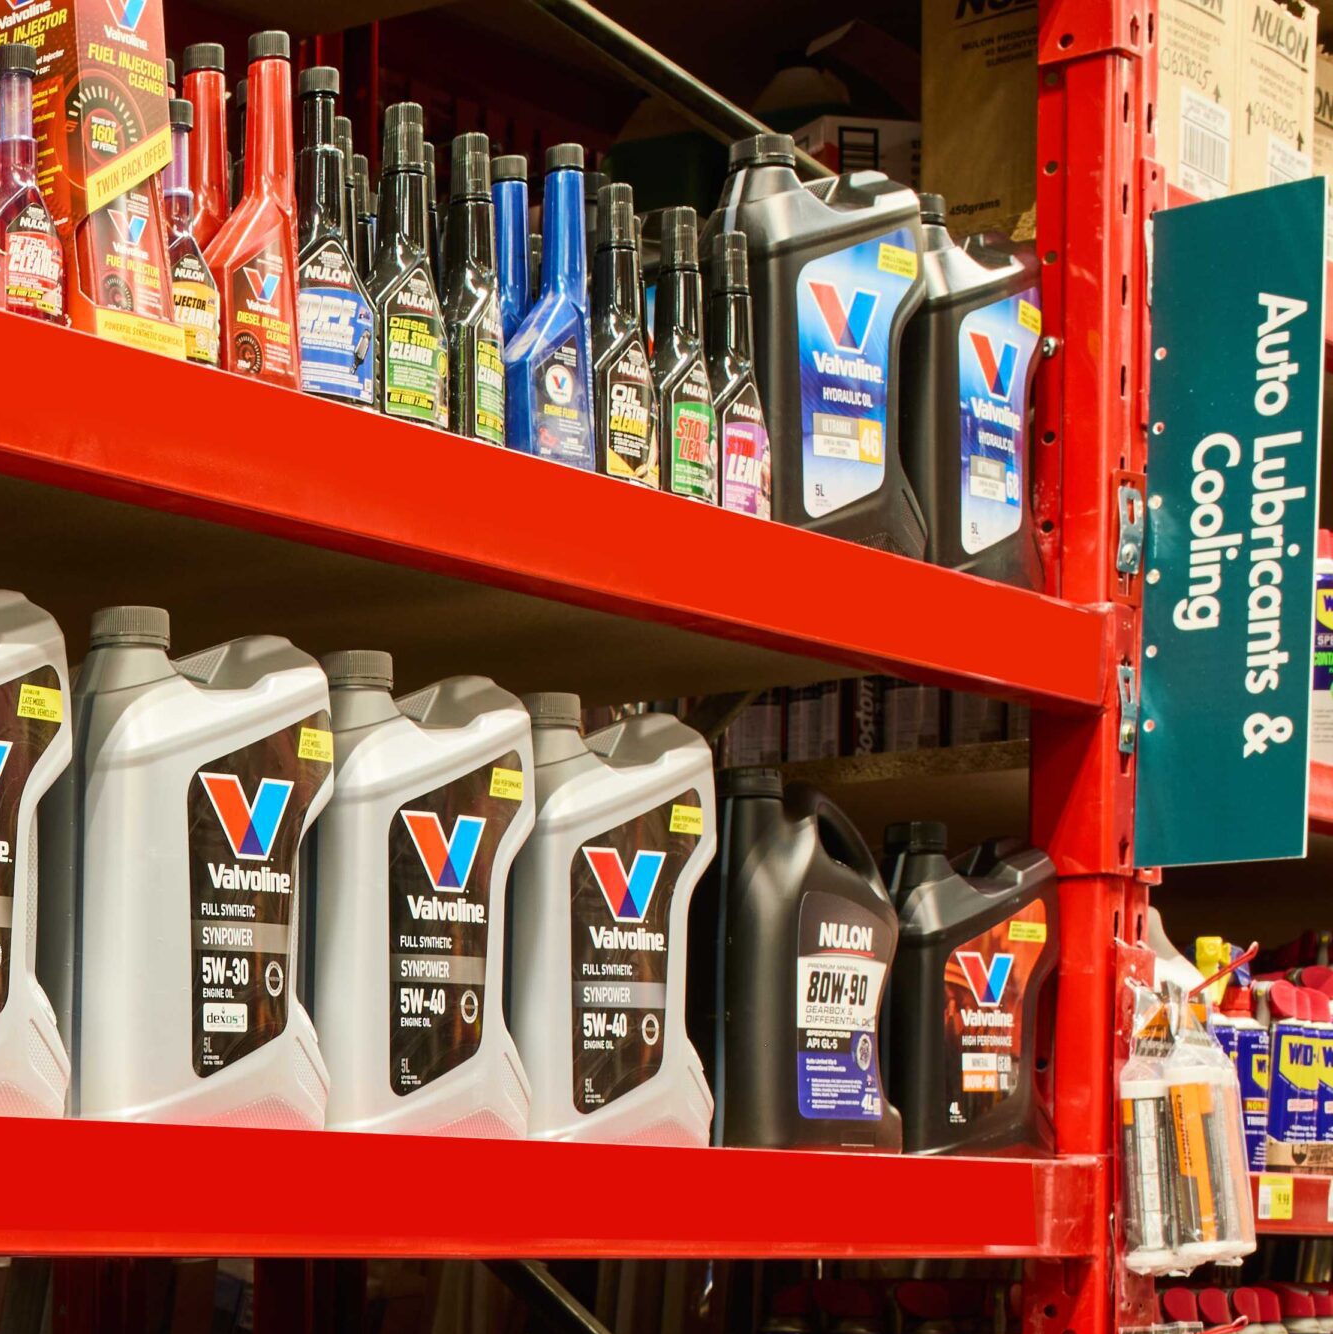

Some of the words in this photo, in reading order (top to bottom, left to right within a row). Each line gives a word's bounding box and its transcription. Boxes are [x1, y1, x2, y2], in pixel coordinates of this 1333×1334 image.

[13, 8, 68, 41] INJECTOR
[104, 25, 149, 50] Valvoline
[1252, 6, 1309, 64] NULON
[88, 43, 117, 65] FUEL
[119, 53, 164, 80] INJECTOR
[128, 73, 164, 96] CLEANER
[96, 172, 120, 197] TWIN
[119, 159, 143, 181] PACK
[143, 141, 167, 168] OFFER
[949, 199, 1001, 216] 450grams
[20, 217, 50, 231] NULON
[305, 265, 352, 285] NULON
[397, 291, 433, 311] NULON
[389, 317, 430, 334] DIESEL
[389, 343, 433, 366] CLEANER
[812, 351, 884, 384] Valvoline
[1255, 291, 1308, 418] Auto
[618, 362, 648, 380] NULON
[611, 384, 640, 406] OIL
[683, 383, 709, 400] NULON
[676, 417, 709, 442] STOP
[860, 431, 880, 458] 46
[1172, 430, 1244, 632] Cooling
[1245, 430, 1307, 695] Lubricants
[1243, 712, 1294, 759] &
[407, 895, 487, 924] Valvoline
[819, 922, 873, 952] NULON
[806, 971, 867, 1006] 80W-90
[400, 988, 446, 1017] 5W-40
[583, 1012, 628, 1039] 5W-40
